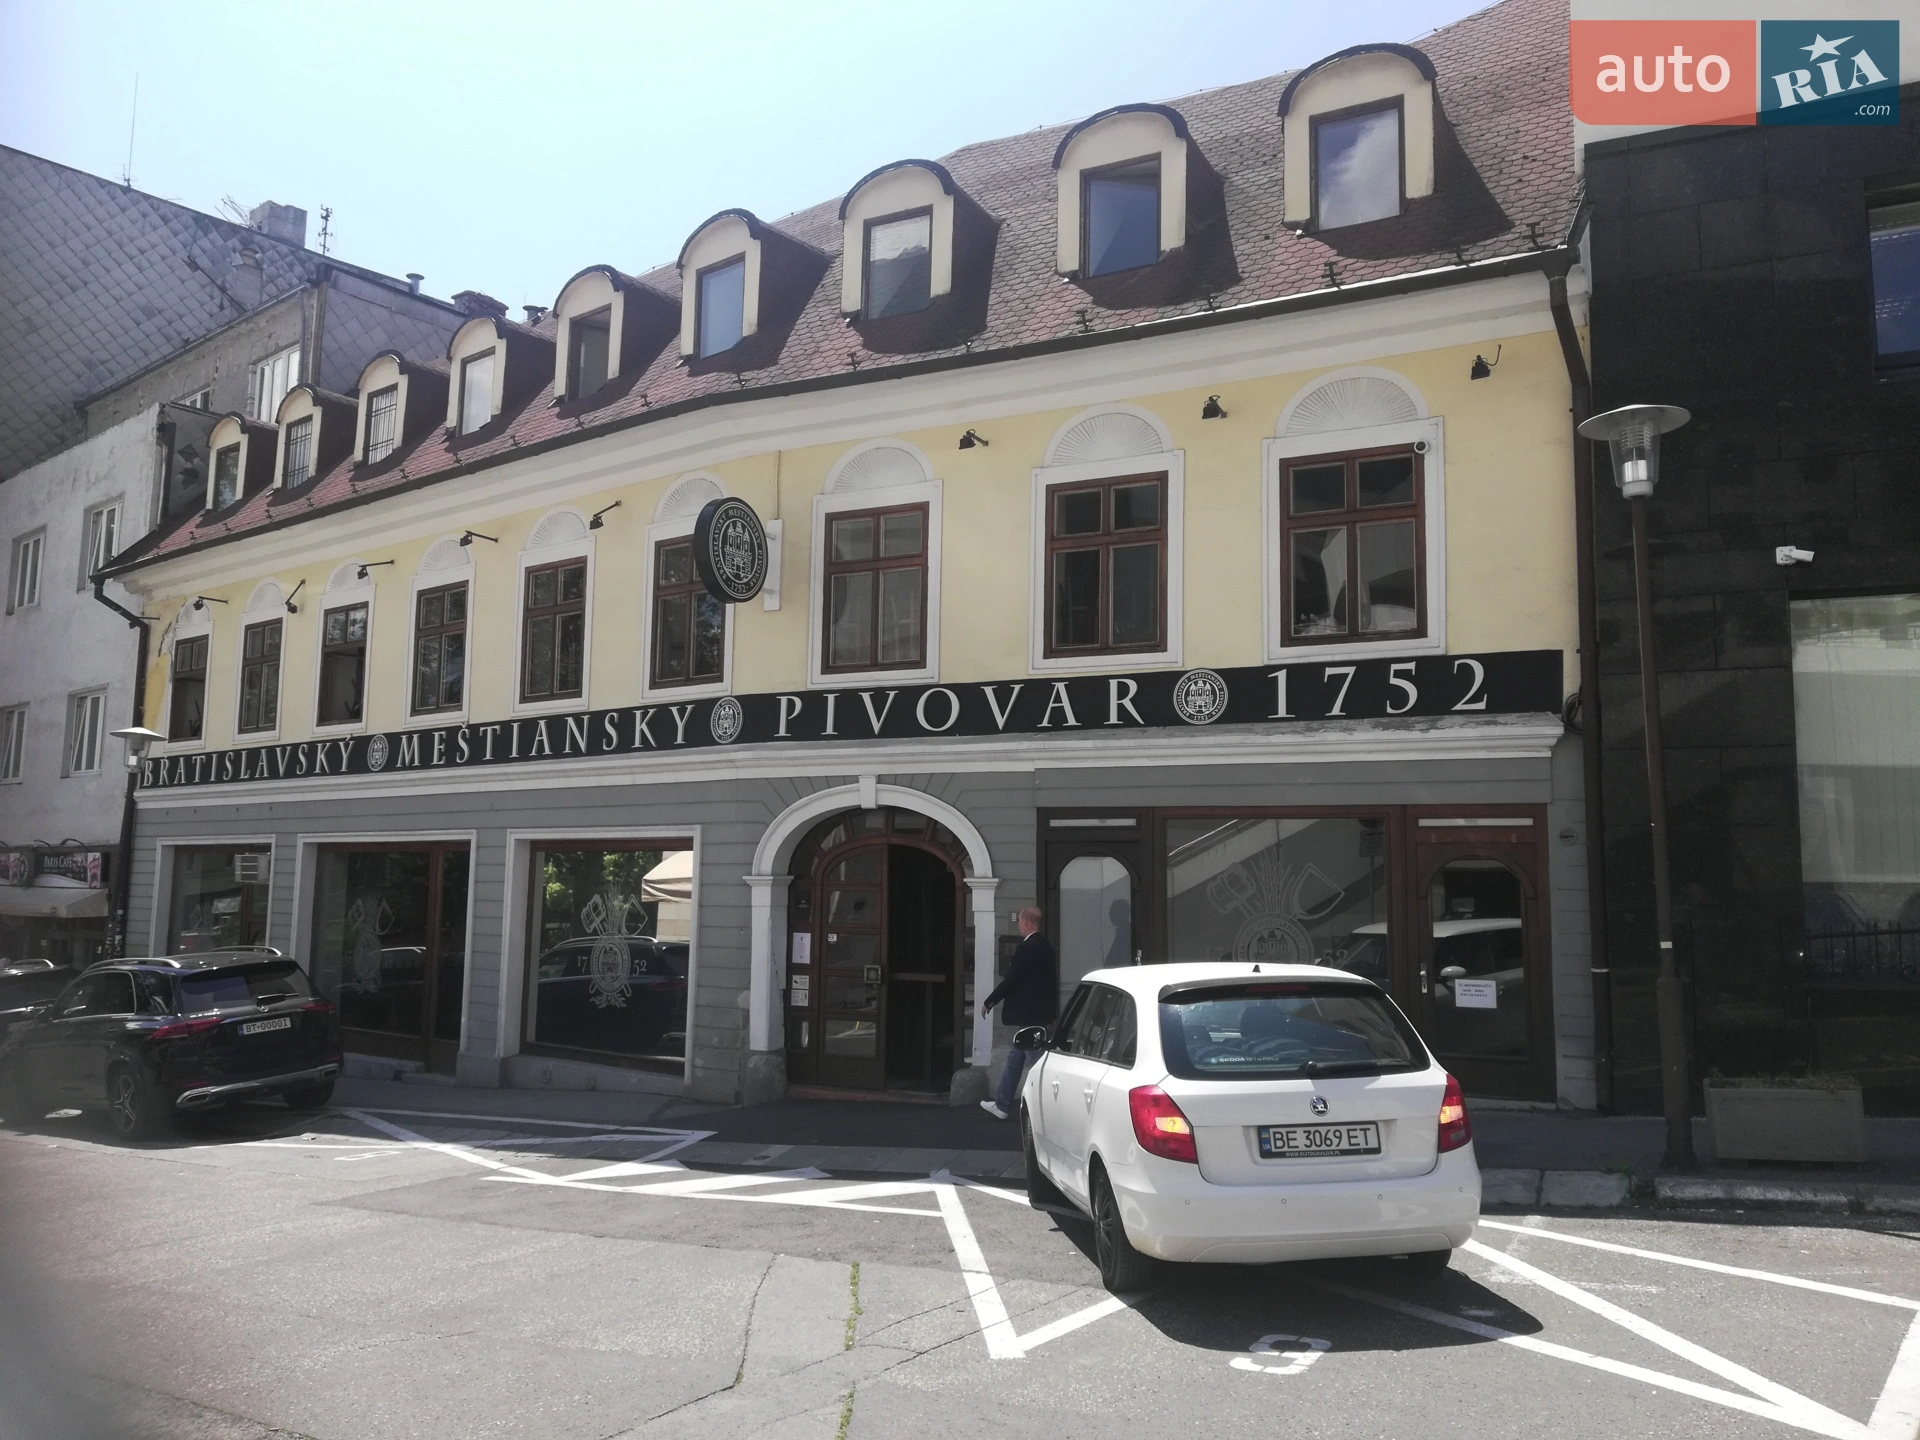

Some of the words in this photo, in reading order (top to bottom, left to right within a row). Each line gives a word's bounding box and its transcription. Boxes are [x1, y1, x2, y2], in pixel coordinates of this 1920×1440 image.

[143, 735, 356, 787] BRATISLAVSKÝ
[395, 704, 695, 768] MEŠTIANSKY
[774, 678, 1145, 736] PIVOVAR
[1268, 658, 1488, 719] 1752
[43, 855, 58, 868] PARIS
[632, 959, 647, 977] 52
[1273, 1130, 1300, 1150] BE
[1303, 1129, 1343, 1149] 3069
[1347, 1127, 1371, 1146] ET
